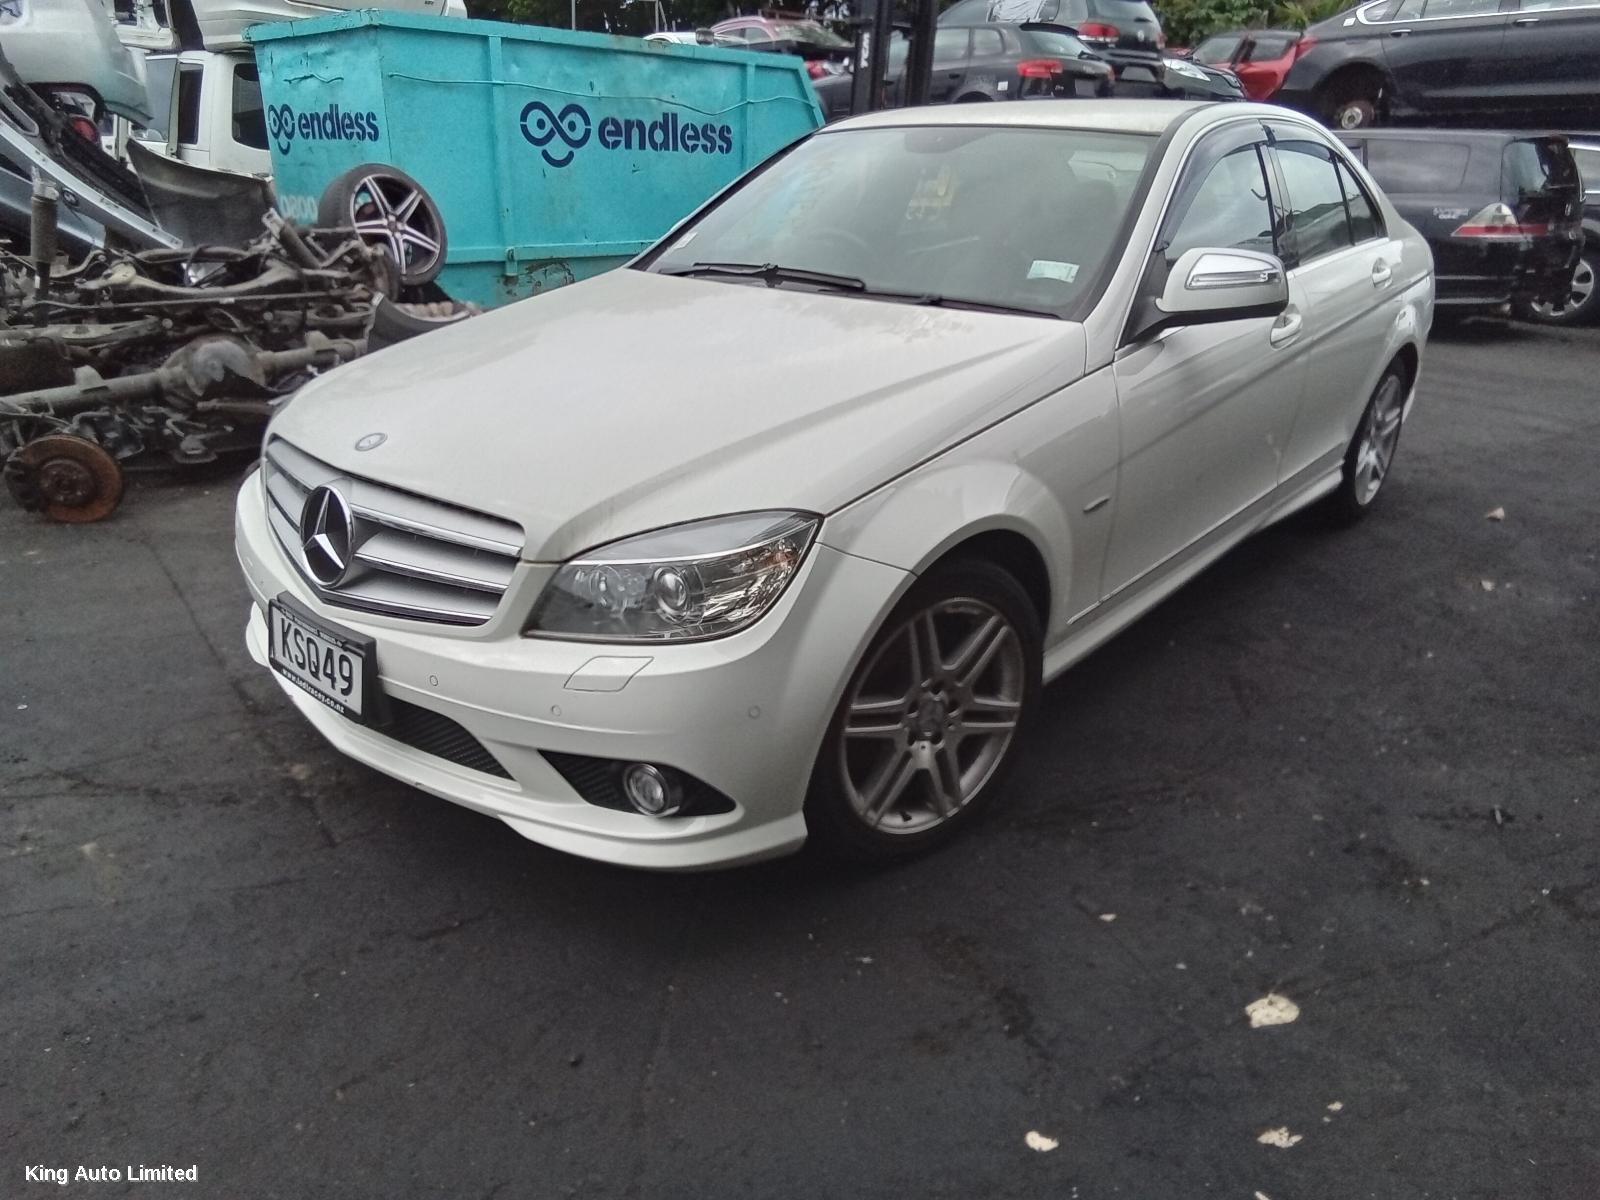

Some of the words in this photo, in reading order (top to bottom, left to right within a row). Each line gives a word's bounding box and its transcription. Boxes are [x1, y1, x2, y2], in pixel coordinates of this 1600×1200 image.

[298, 104, 379, 141] endless
[598, 112, 732, 154] endless
[281, 617, 353, 696] KSQ49
